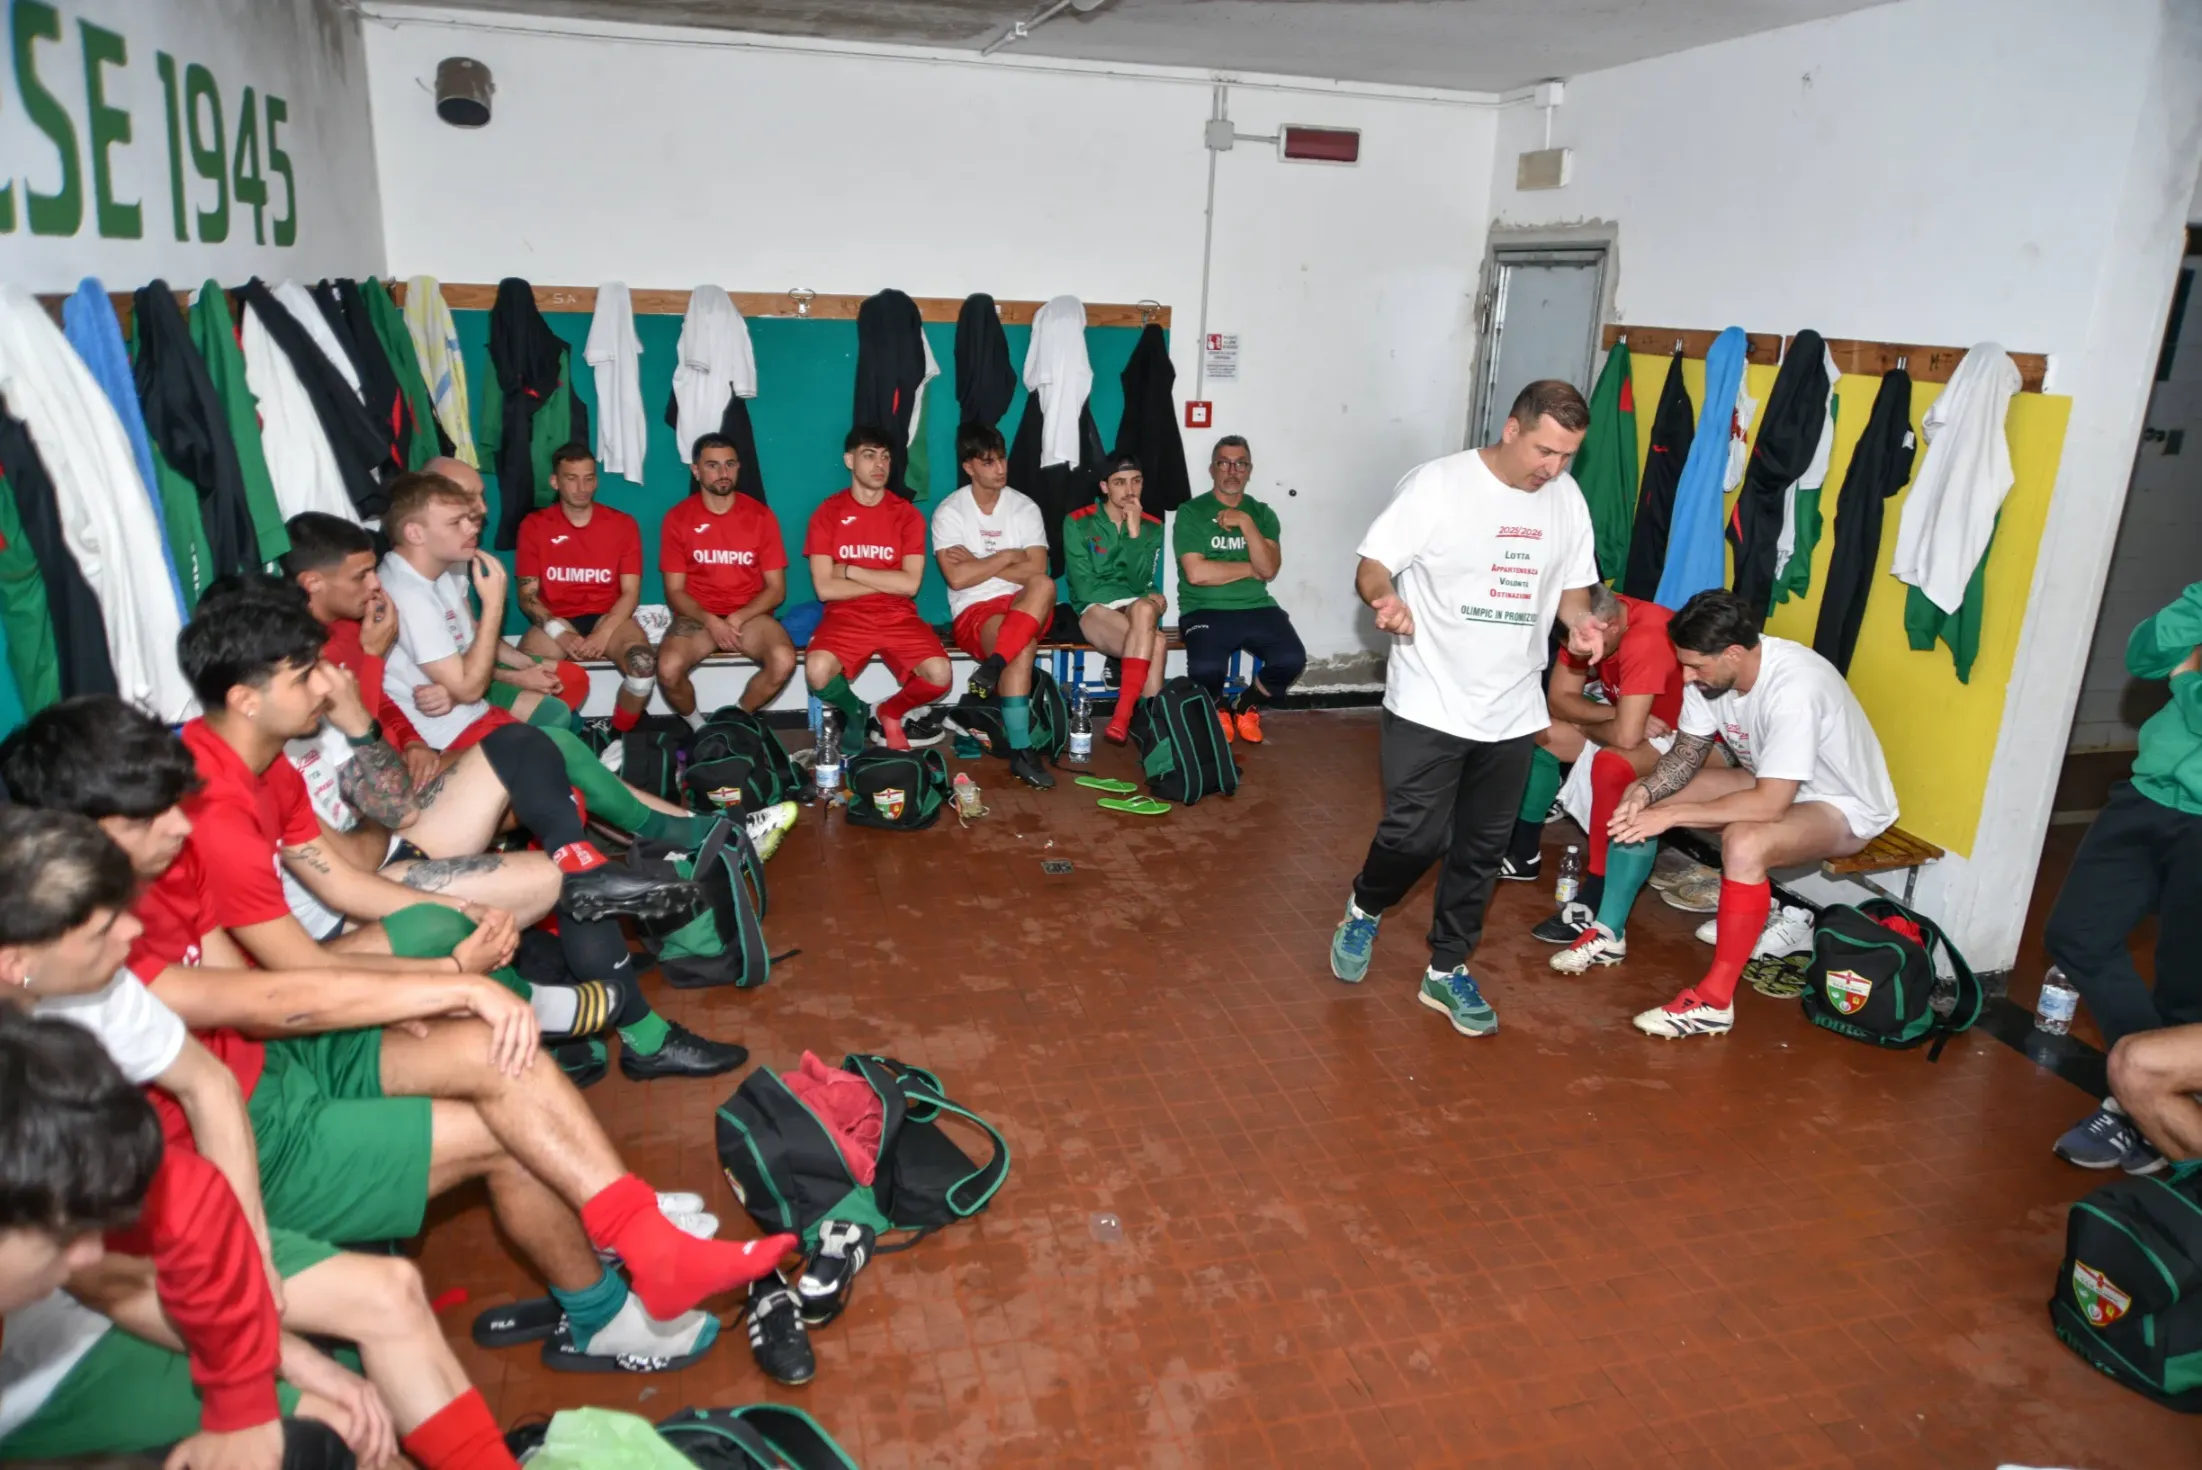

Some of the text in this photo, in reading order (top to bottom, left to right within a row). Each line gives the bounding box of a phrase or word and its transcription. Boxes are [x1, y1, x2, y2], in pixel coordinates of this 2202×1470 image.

[0, 0, 297, 247] SE 1945
[1498, 526, 1543, 537] 2025/2026
[693, 549, 754, 565] OLIMPIC
[839, 544, 894, 561] OLIMPIC
[546, 566, 612, 583] OLIMPIC
[1461, 605, 1494, 618] OLIMPIC
[1494, 610, 1503, 620] IN
